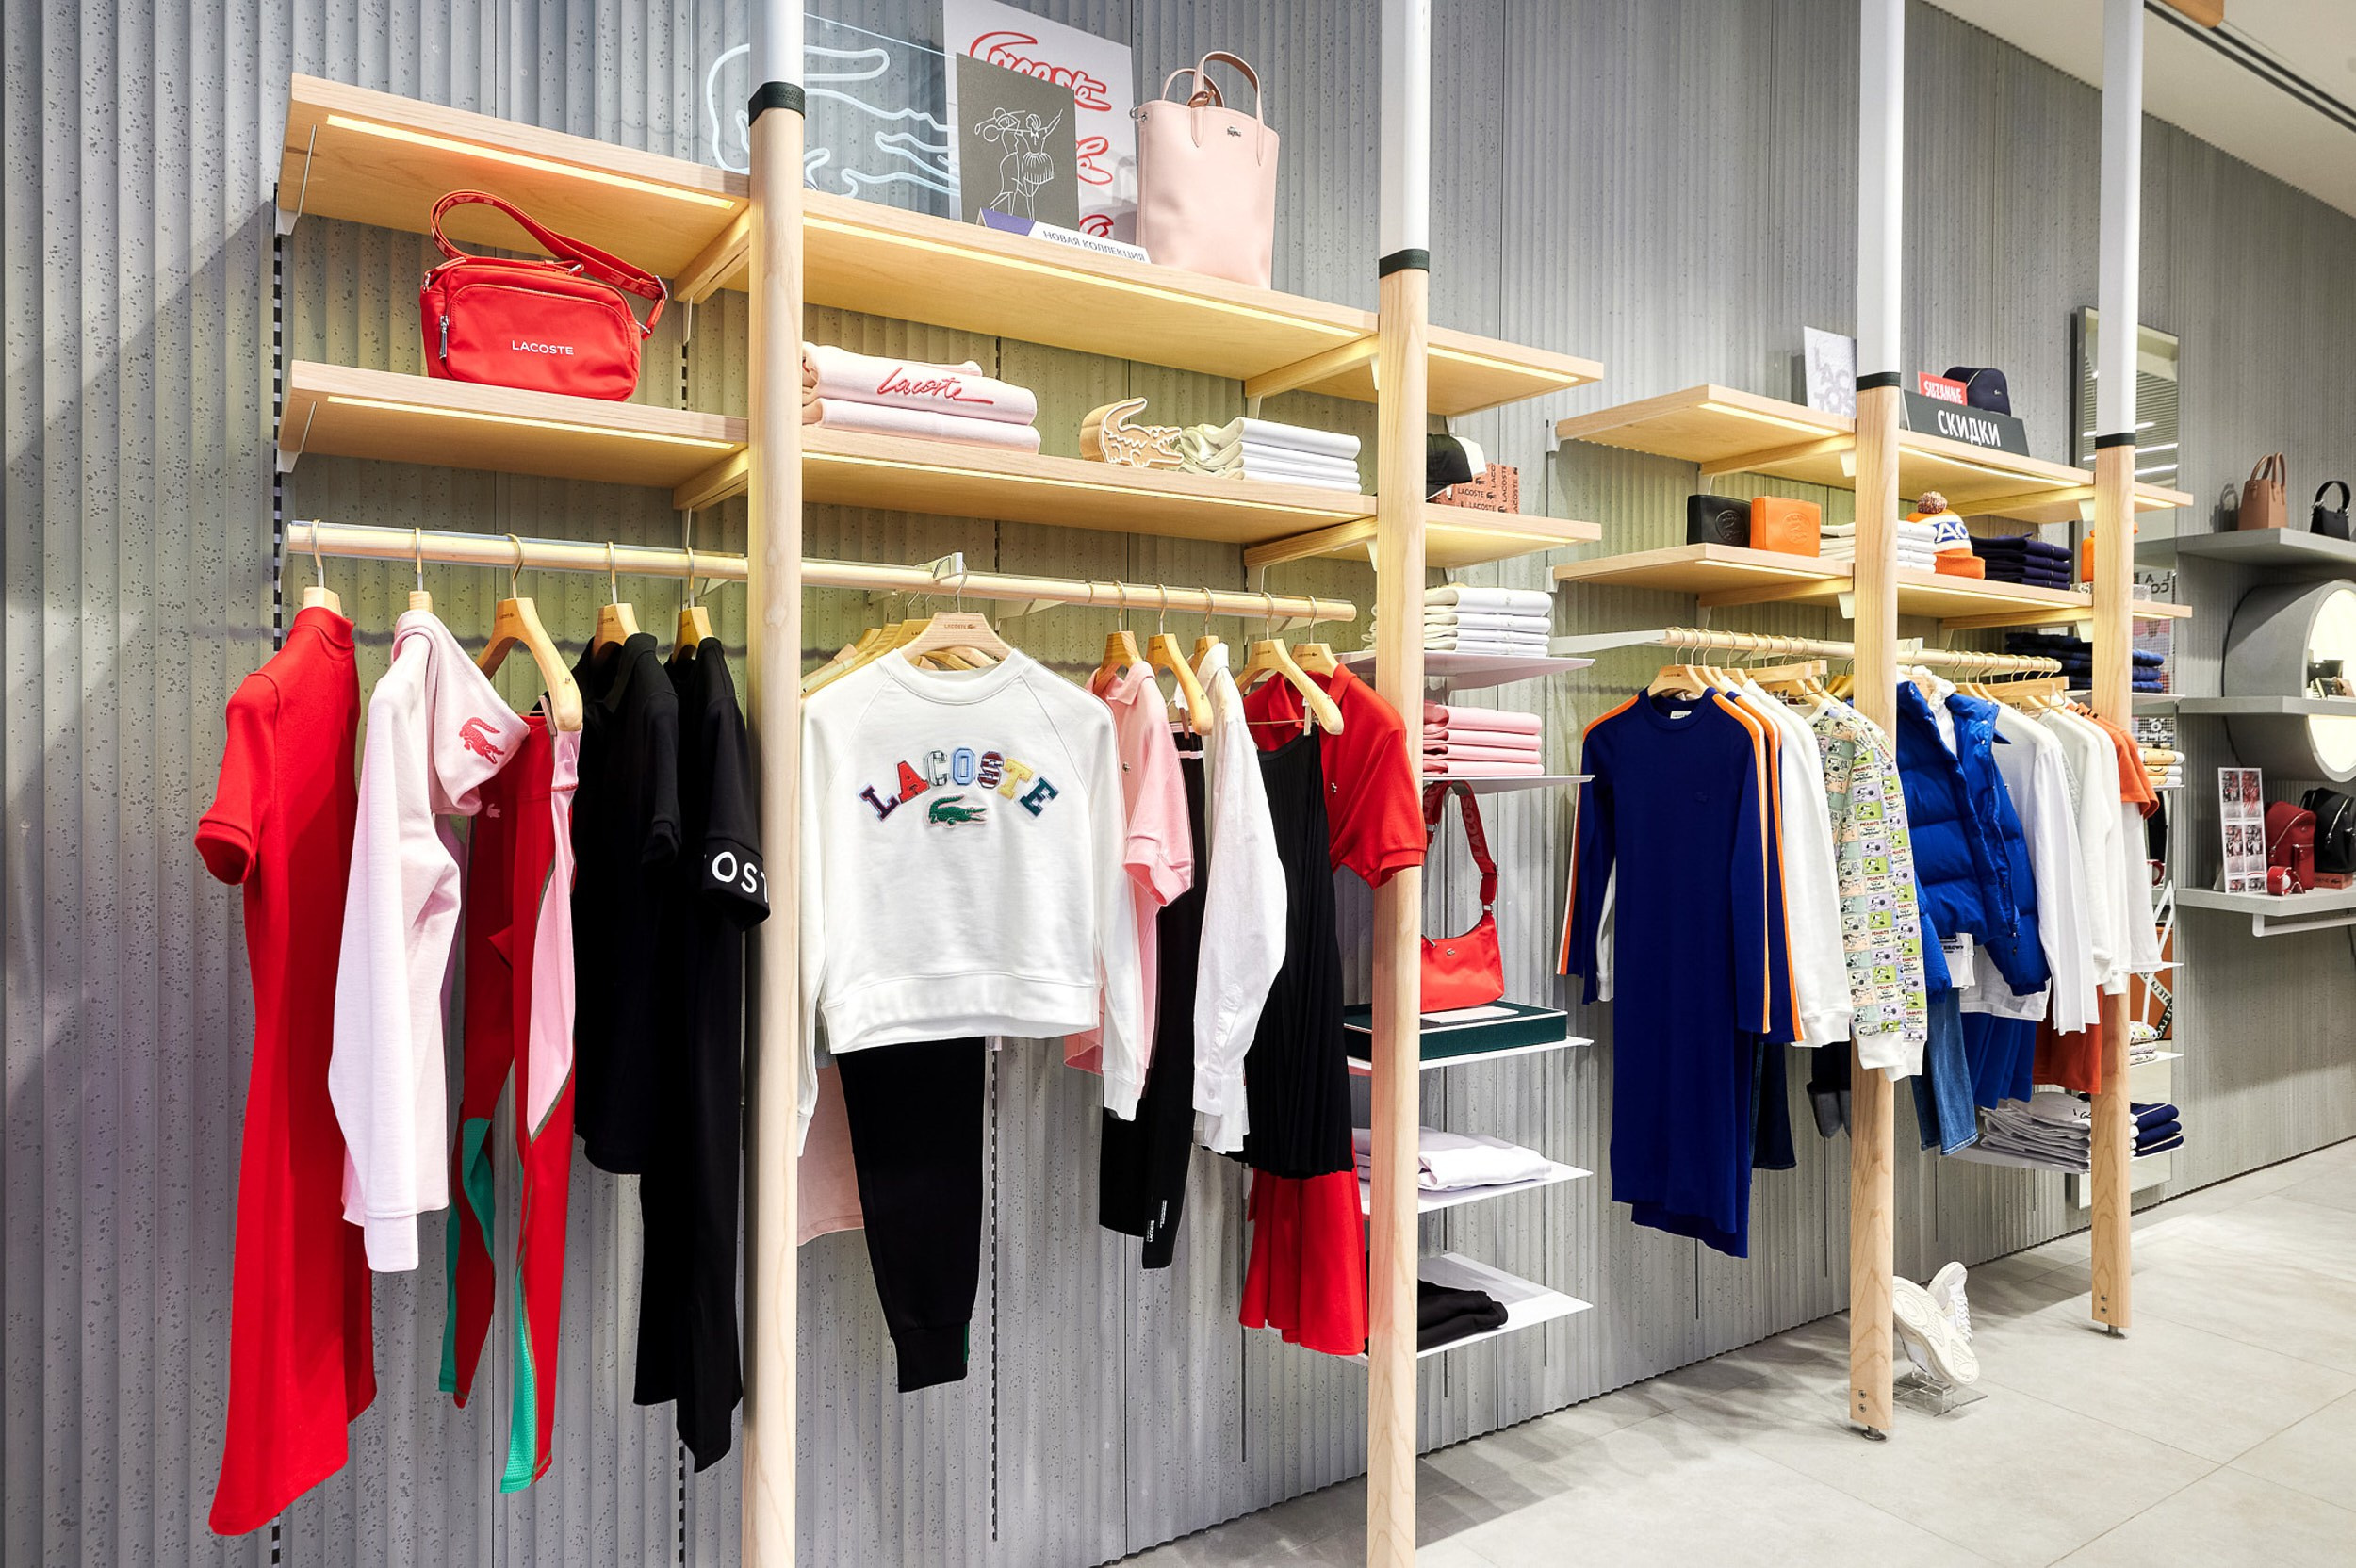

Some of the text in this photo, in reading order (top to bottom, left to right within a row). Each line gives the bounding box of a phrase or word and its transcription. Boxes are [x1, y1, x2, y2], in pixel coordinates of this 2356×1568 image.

[1042, 230, 1146, 262] НОВАЯ КОЛЛЕКЦИЯ
[512, 340, 574, 356] LACOSTE
[877, 367, 994, 405] Lacoste
[1923, 380, 1963, 404] SUZANNE
[1937, 409, 2002, 448] СКИДКИ
[1458, 487, 1484, 498] LACOSTE
[858, 748, 1060, 823] LACOSTE
